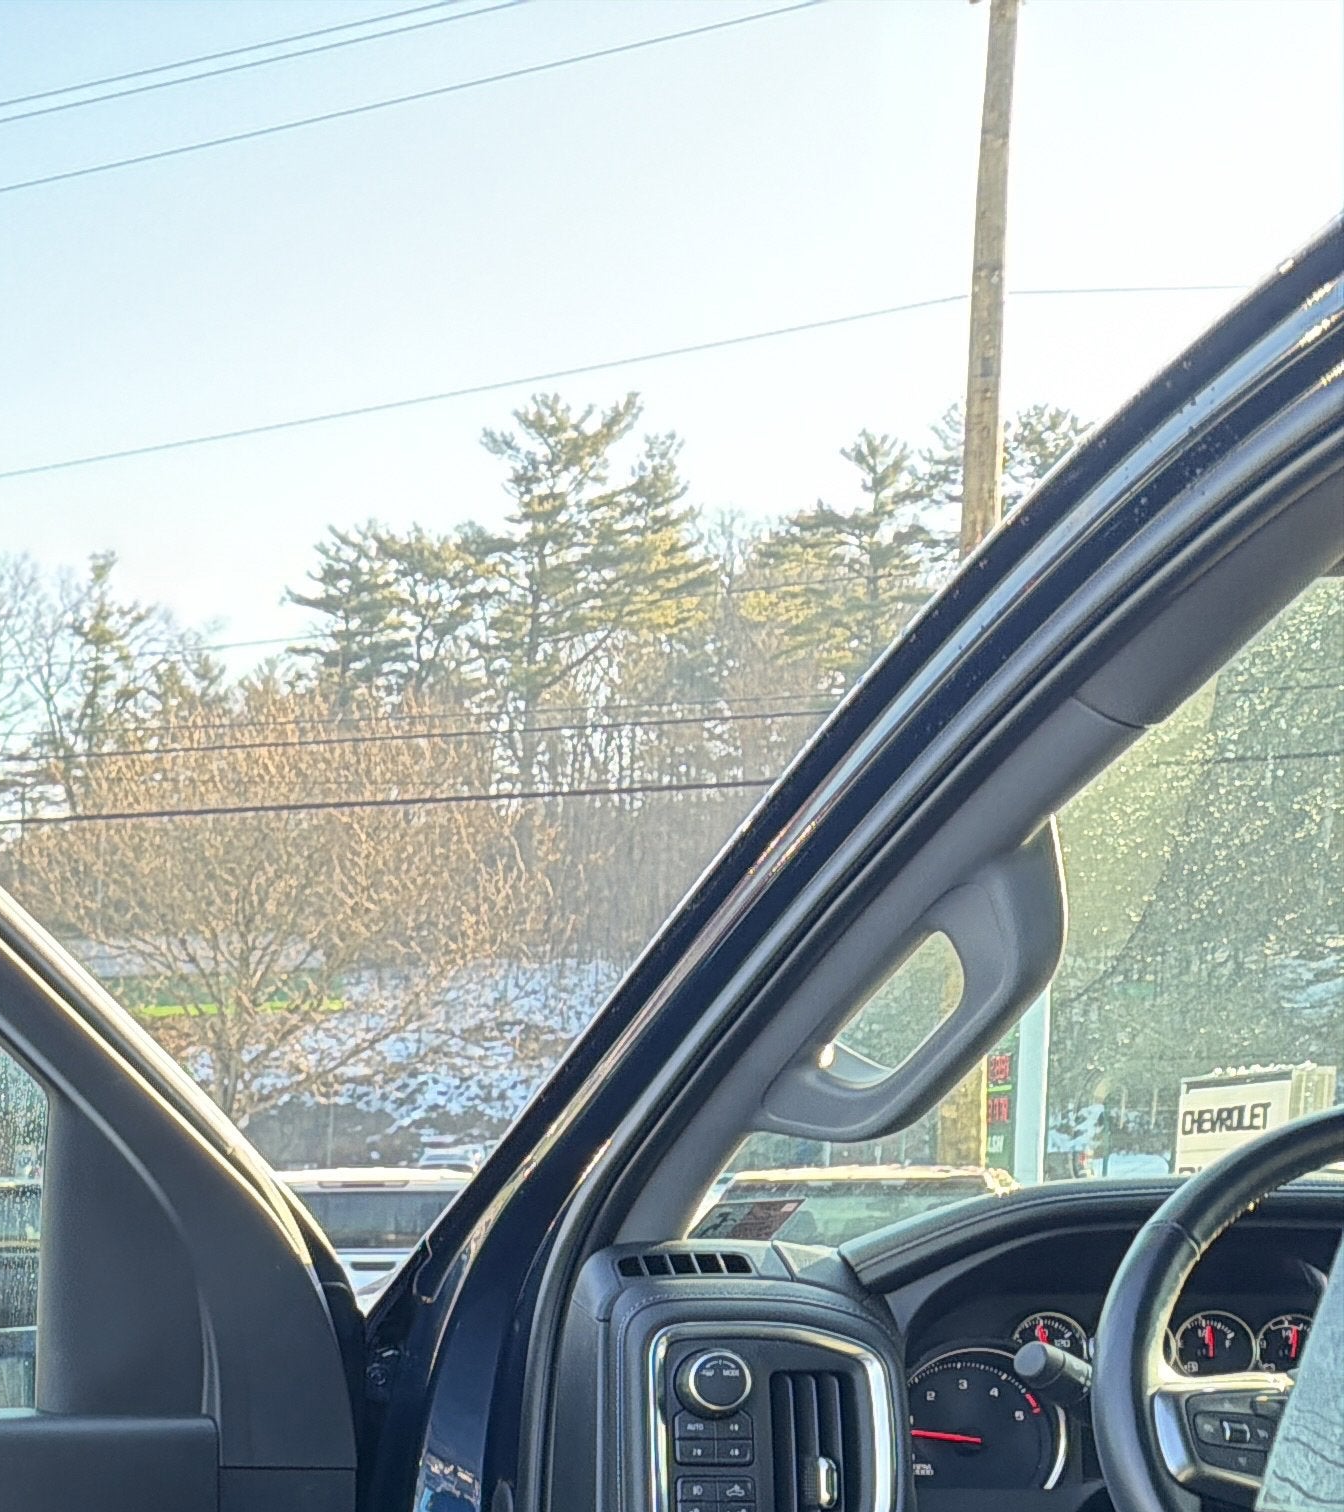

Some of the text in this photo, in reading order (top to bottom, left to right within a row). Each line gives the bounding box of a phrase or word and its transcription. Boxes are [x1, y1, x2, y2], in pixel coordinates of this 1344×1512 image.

[1181, 1101, 1272, 1136] CHEVROLET
[958, 1379, 968, 1390] 3
[989, 1387, 999, 1398] 4
